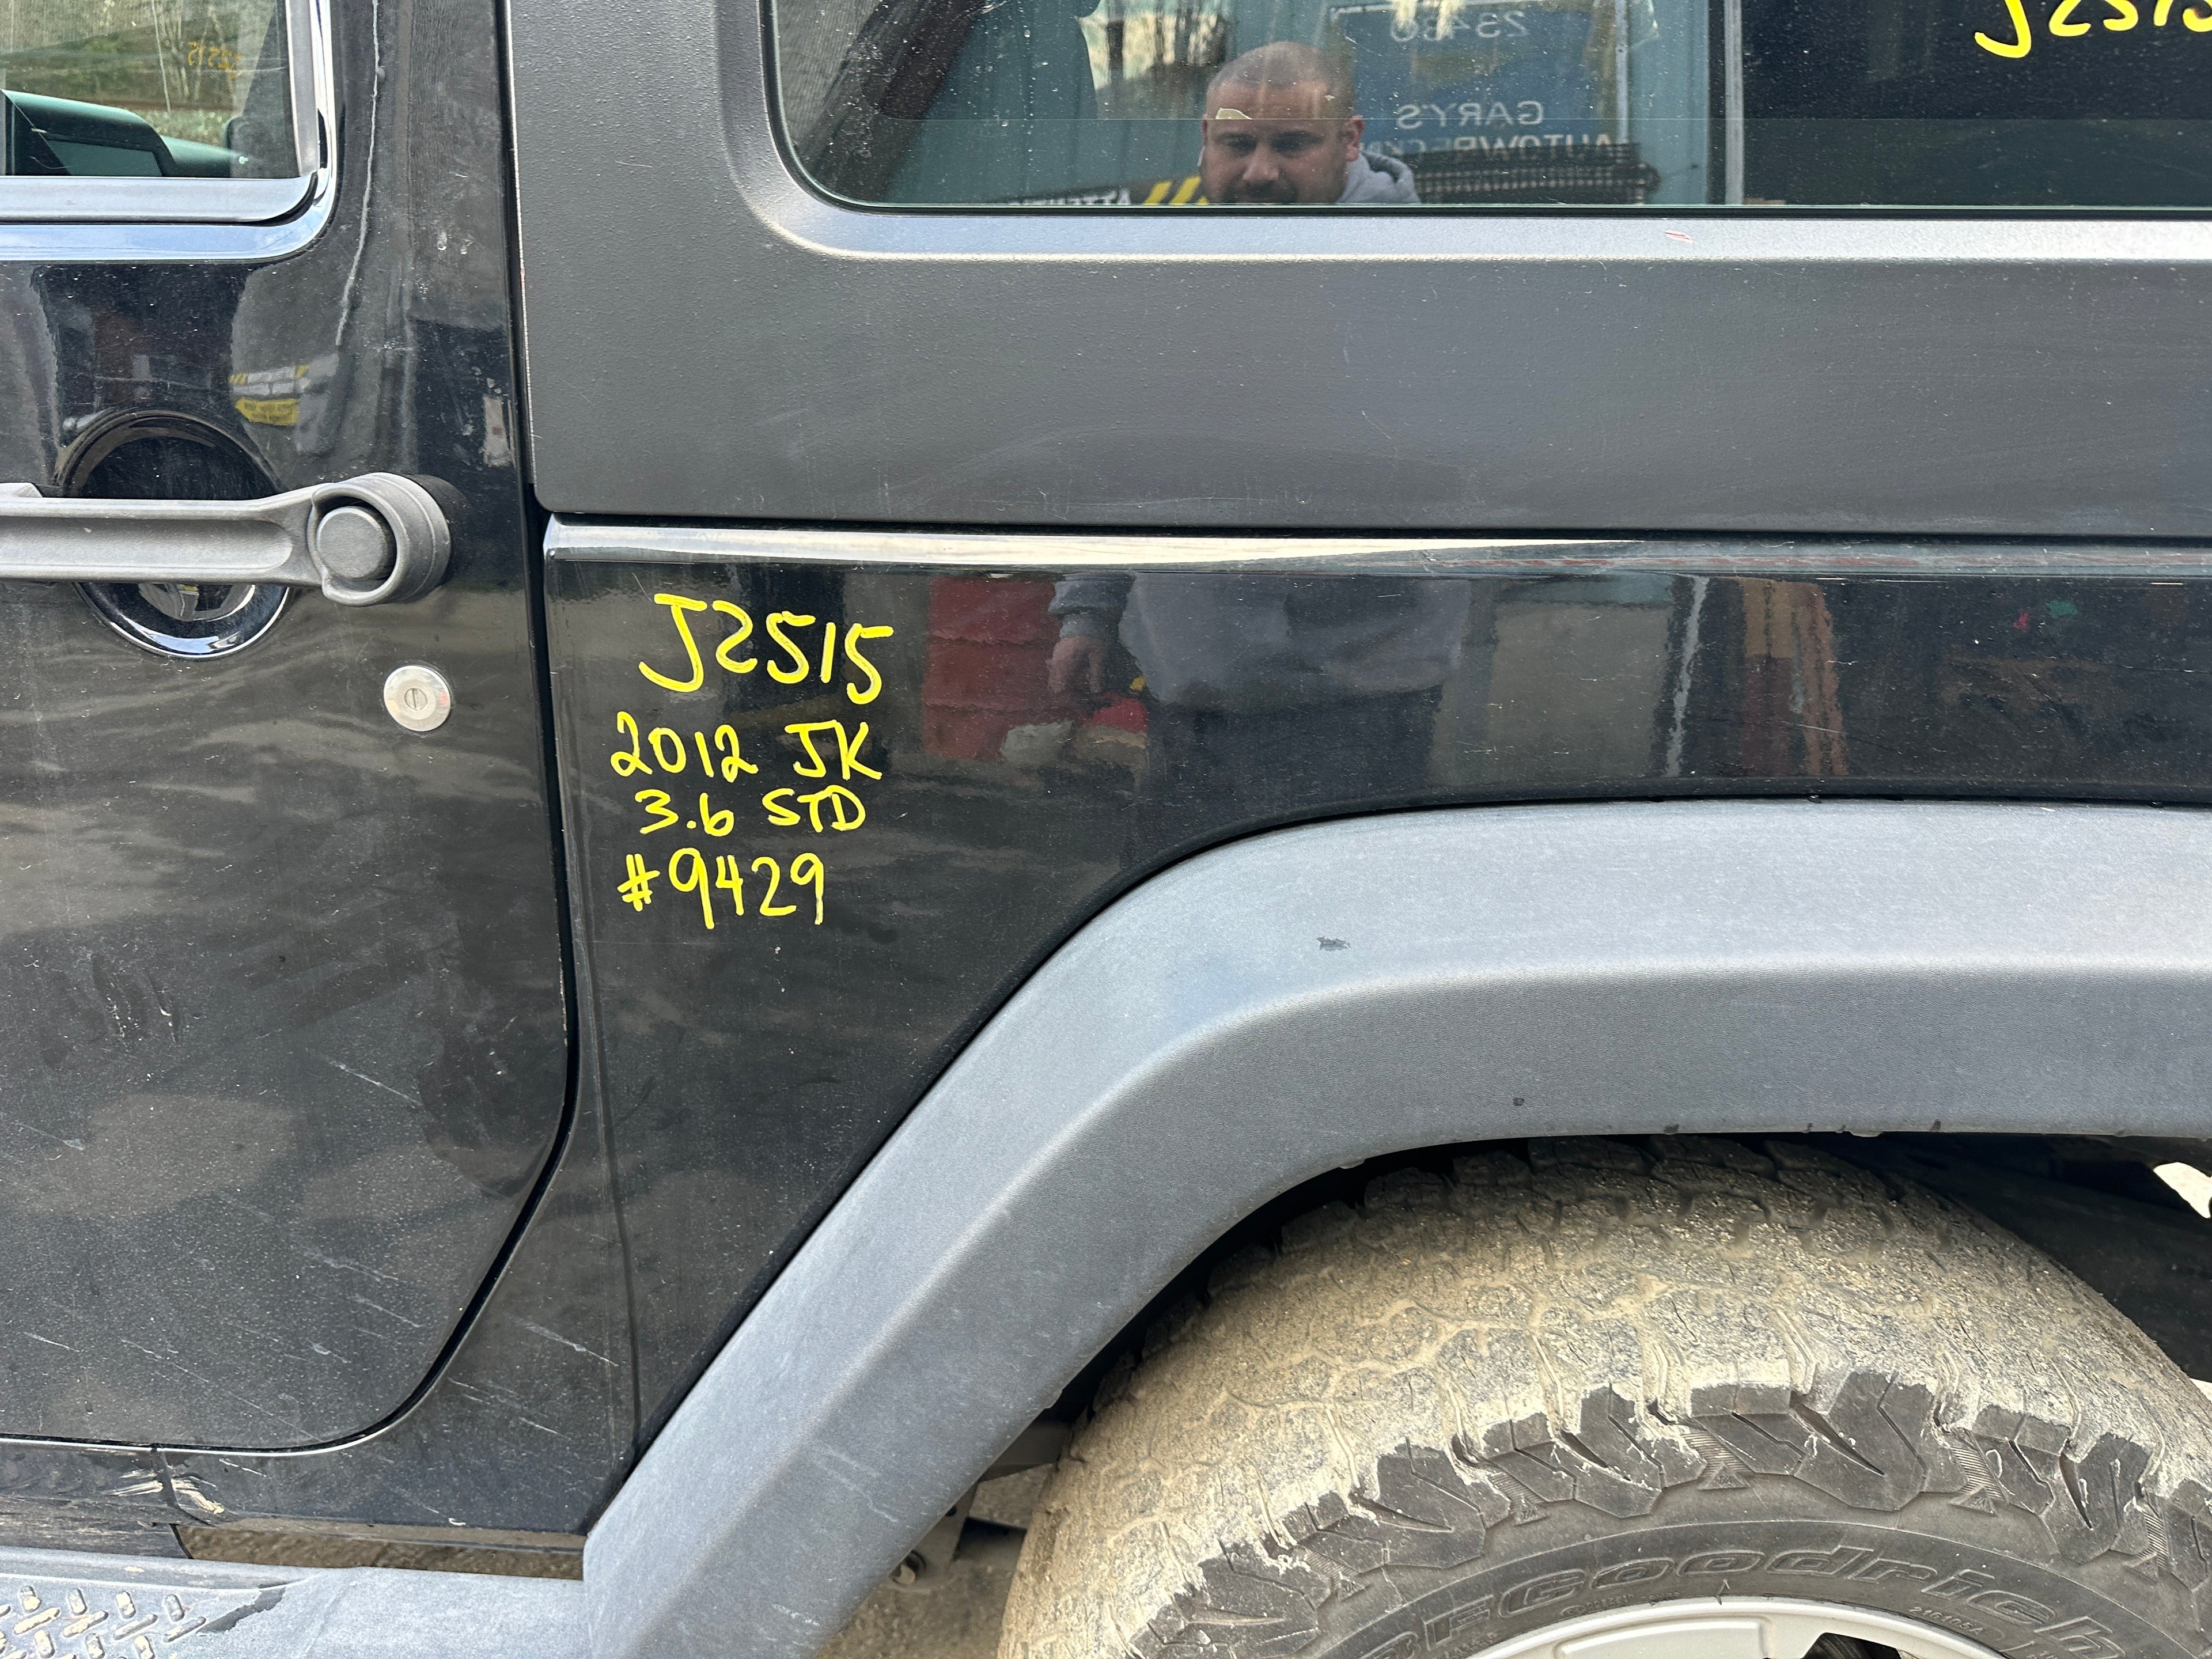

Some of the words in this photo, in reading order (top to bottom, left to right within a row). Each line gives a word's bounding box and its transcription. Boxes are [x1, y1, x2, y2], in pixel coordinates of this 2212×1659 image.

[638, 593, 894, 704] J2515
[611, 712, 759, 782] 2012
[784, 719, 882, 780] JK
[635, 788, 735, 836] 3.6
[762, 784, 866, 832] STD
[616, 847, 824, 929] #9429
